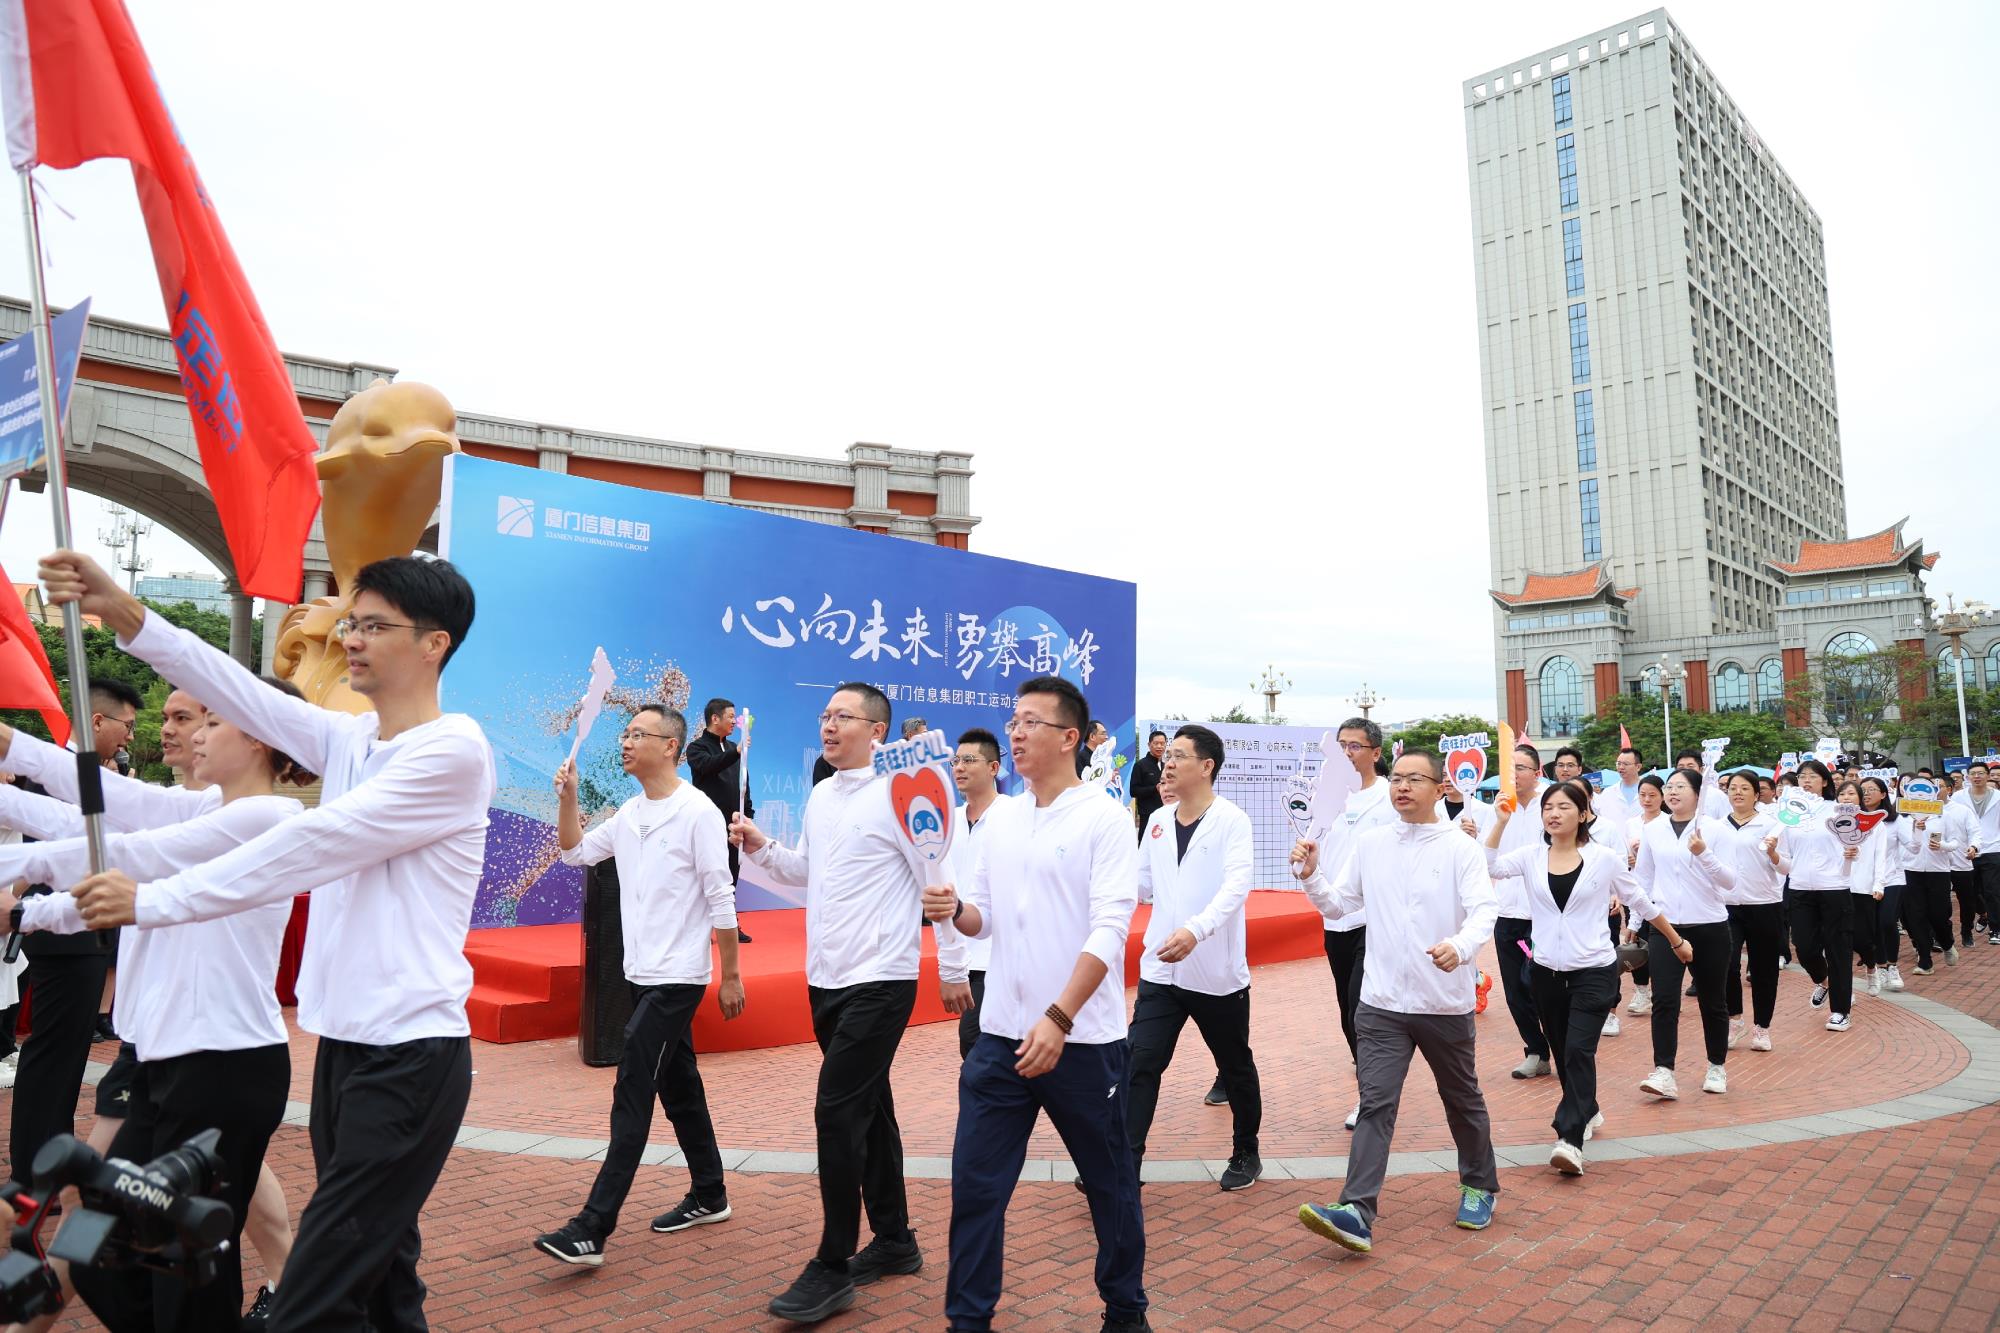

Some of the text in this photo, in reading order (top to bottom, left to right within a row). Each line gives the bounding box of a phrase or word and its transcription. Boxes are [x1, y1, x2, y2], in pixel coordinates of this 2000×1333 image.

[544, 507, 651, 541] 厦门信息集团
[544, 531, 649, 553] XIAMEN INFORMATION GROUP
[721, 592, 1101, 686] 心向未来 勇攀高峰
[114, 1173, 175, 1211] RONIN
